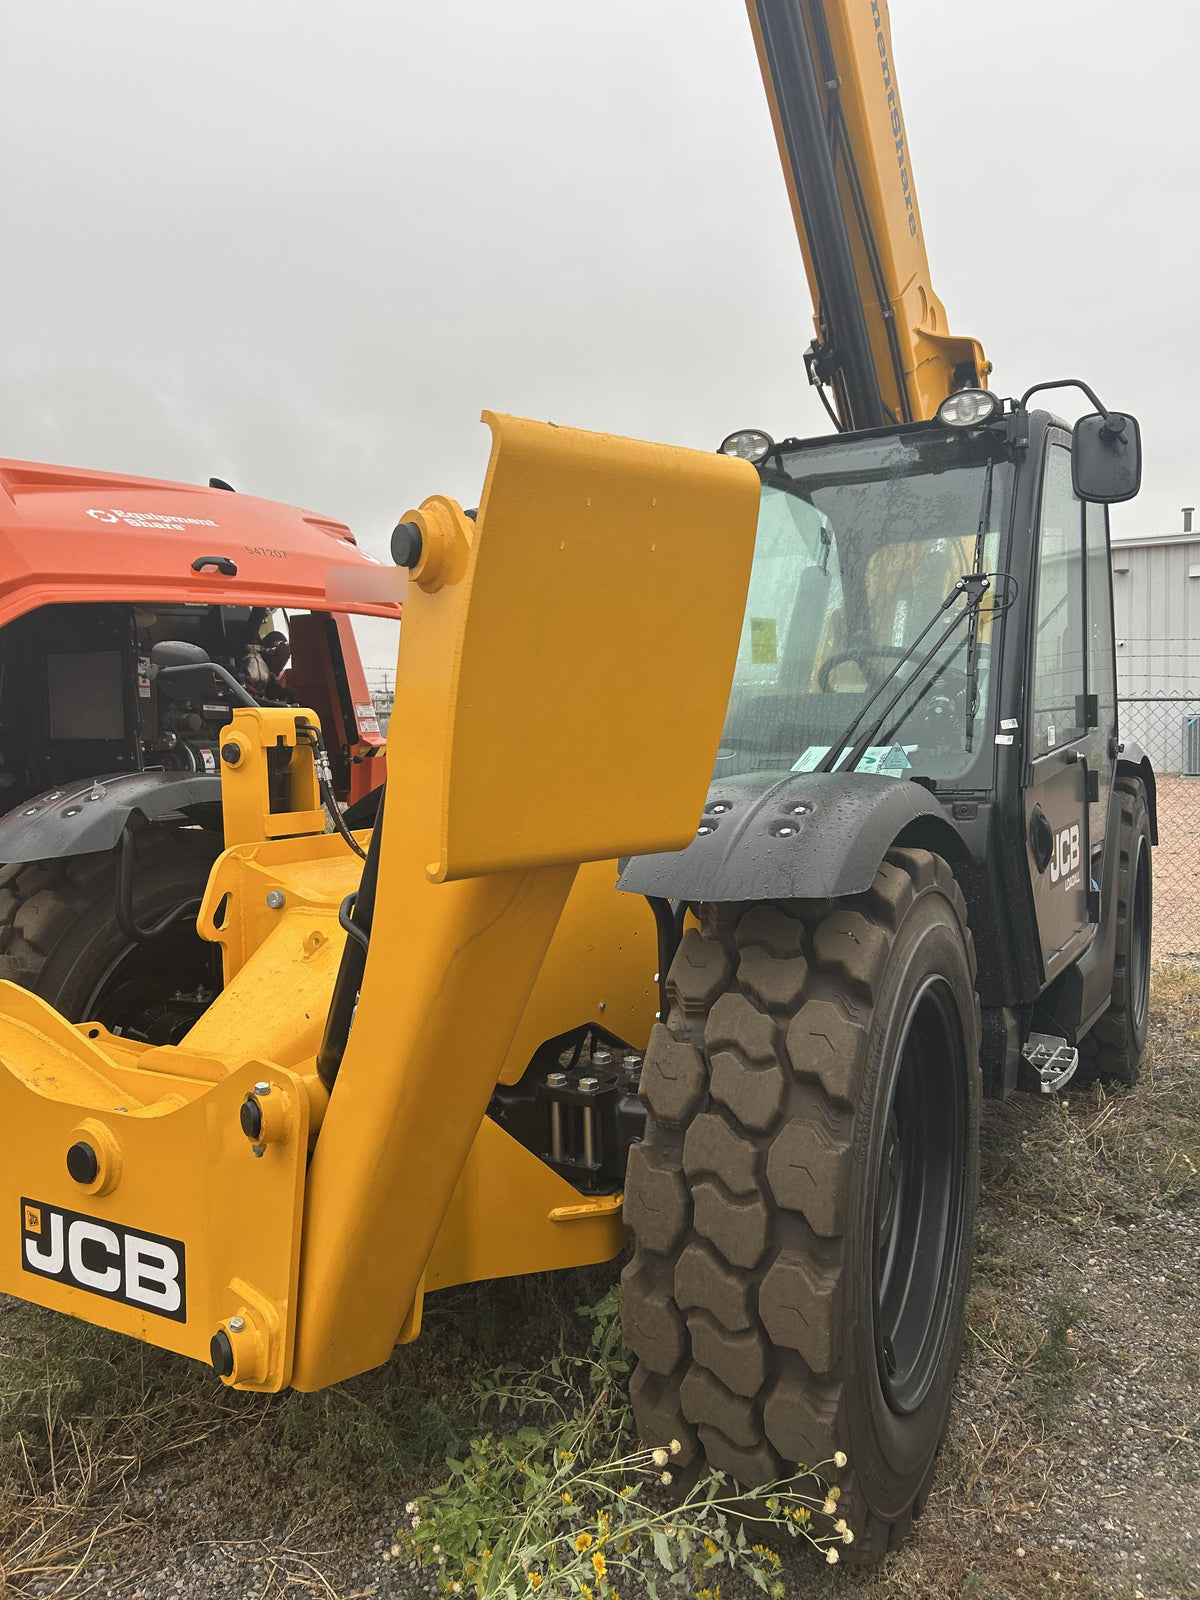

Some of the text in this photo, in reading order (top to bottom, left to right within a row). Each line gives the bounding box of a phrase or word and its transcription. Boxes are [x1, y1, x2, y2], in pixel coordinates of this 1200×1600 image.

[110, 509, 220, 527] Equipment
[124, 518, 185, 531] Share
[245, 546, 288, 559] 547207
[1050, 824, 1080, 883] JCB
[26, 1213, 181, 1312] JCB
